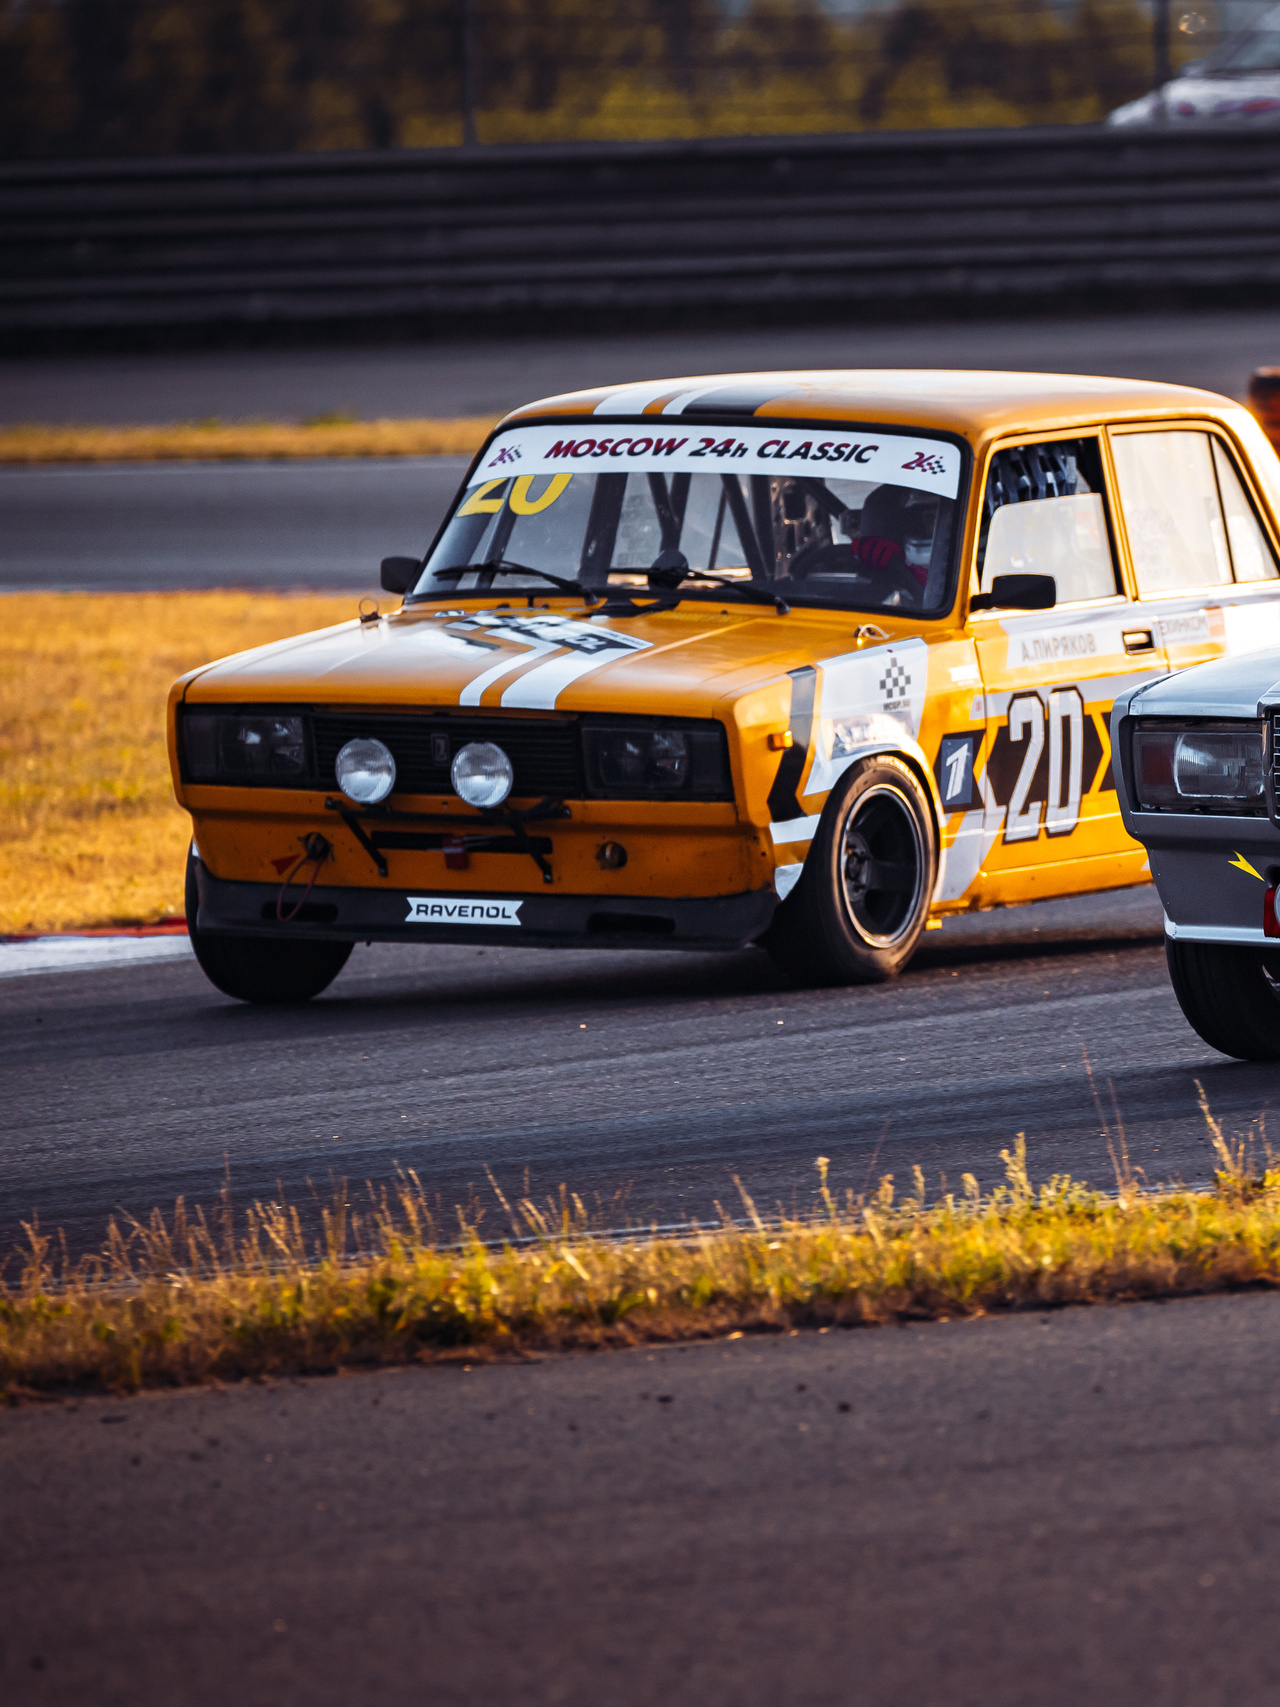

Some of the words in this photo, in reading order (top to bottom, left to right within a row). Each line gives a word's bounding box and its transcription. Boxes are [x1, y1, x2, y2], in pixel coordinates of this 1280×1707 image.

[543, 437, 689, 459] MOSCOW
[688, 437, 749, 458] 24h
[756, 439, 879, 464] CLASSIC
[1002, 685, 1084, 846] 20
[416, 904, 511, 919] RAVENOL
